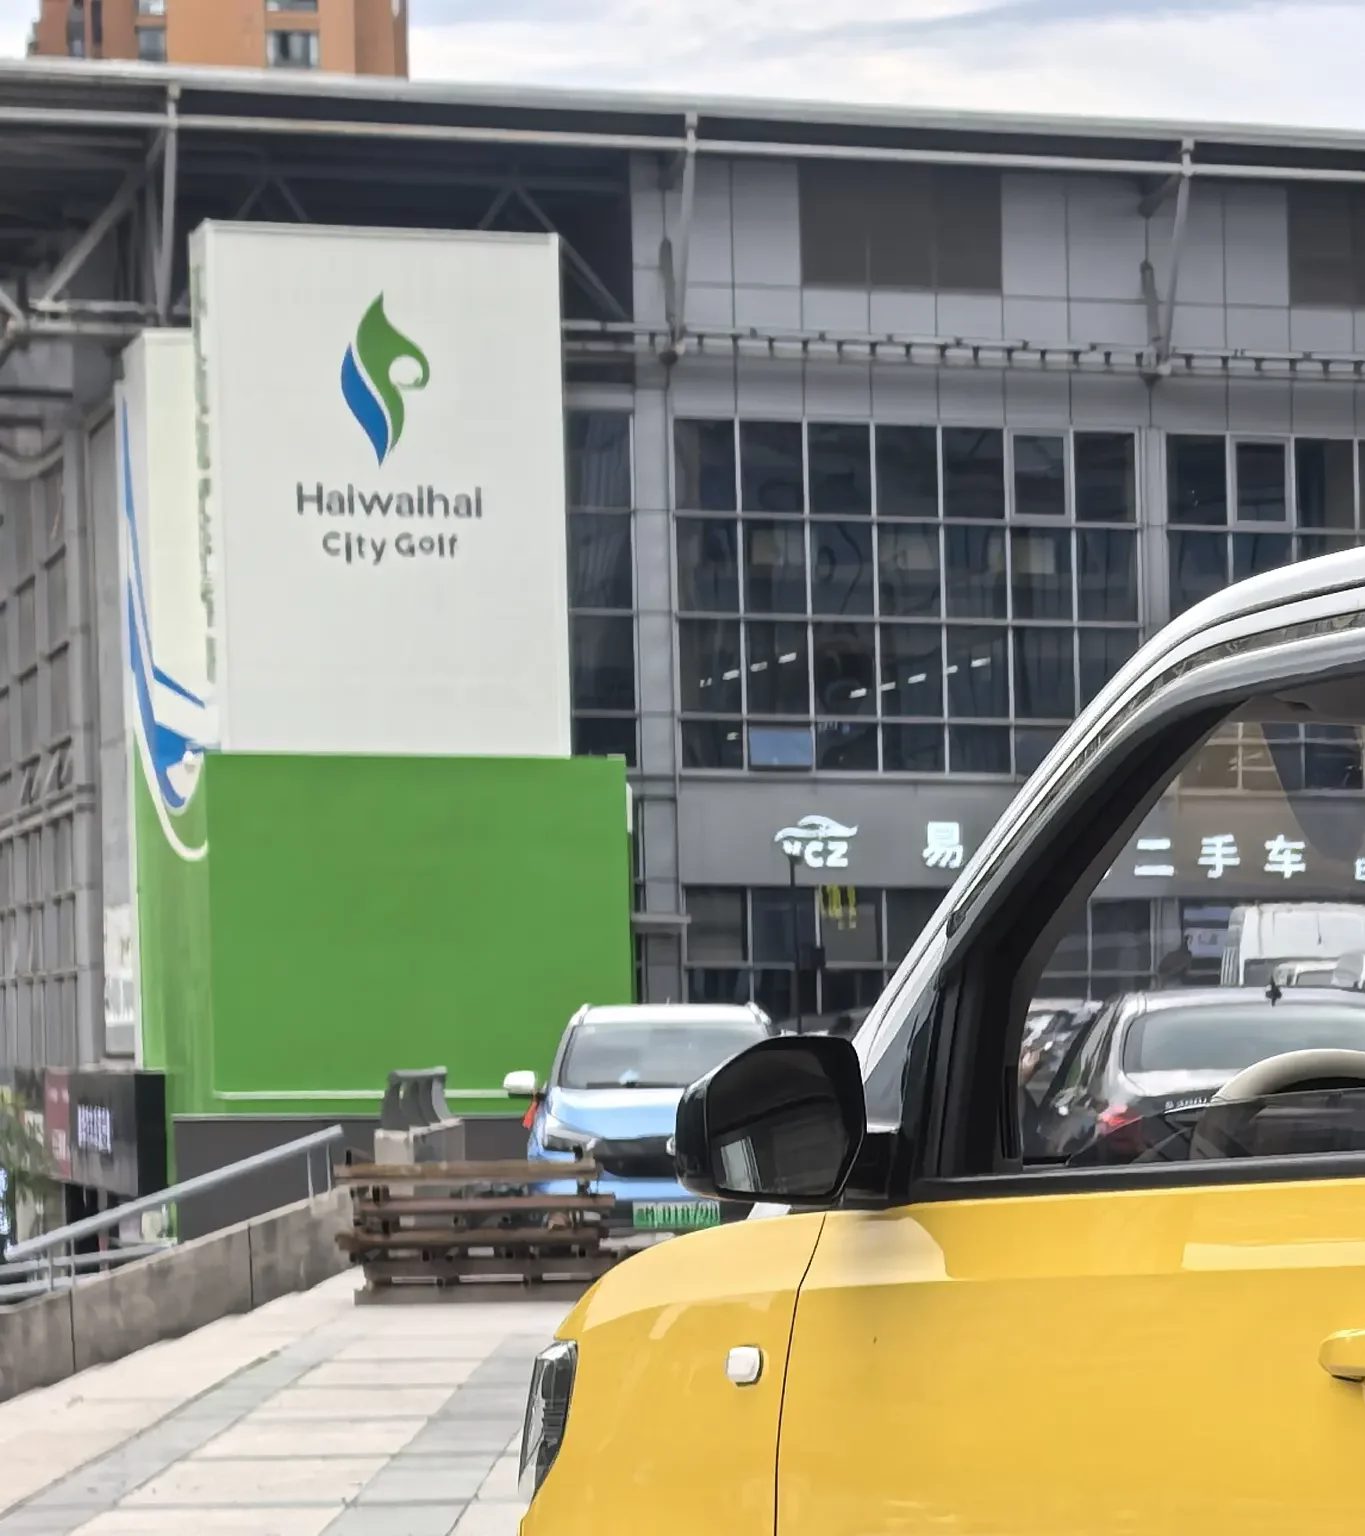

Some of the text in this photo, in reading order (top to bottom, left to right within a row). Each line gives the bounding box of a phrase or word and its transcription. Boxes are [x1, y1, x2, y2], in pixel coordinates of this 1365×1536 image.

[296, 481, 482, 518] Haiwaihai
[322, 530, 458, 566] City Golf
[922, 821, 1306, 879] 易 二手车
